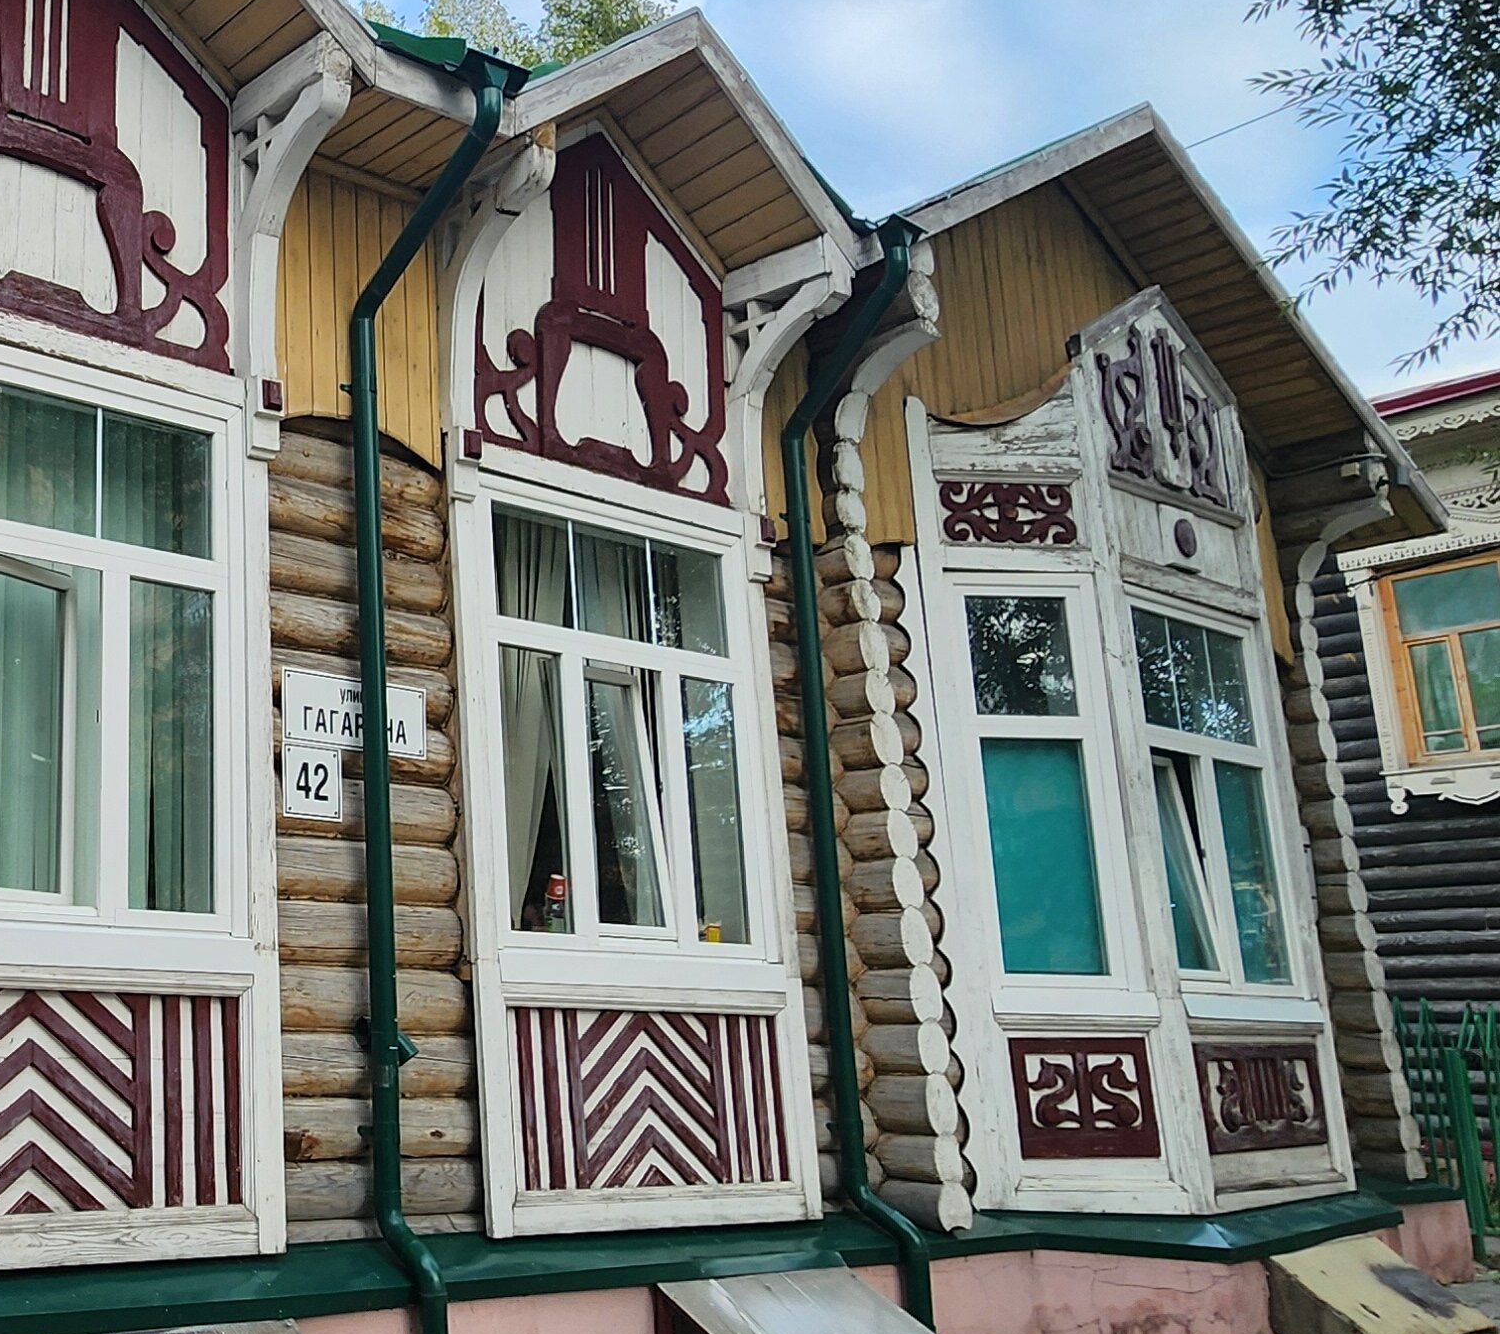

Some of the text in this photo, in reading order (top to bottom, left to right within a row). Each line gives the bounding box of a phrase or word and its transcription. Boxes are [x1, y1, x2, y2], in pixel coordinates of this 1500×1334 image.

[339, 687, 363, 705] ули
[303, 705, 407, 746] ГАГАРНА
[296, 761, 329, 802] 42
